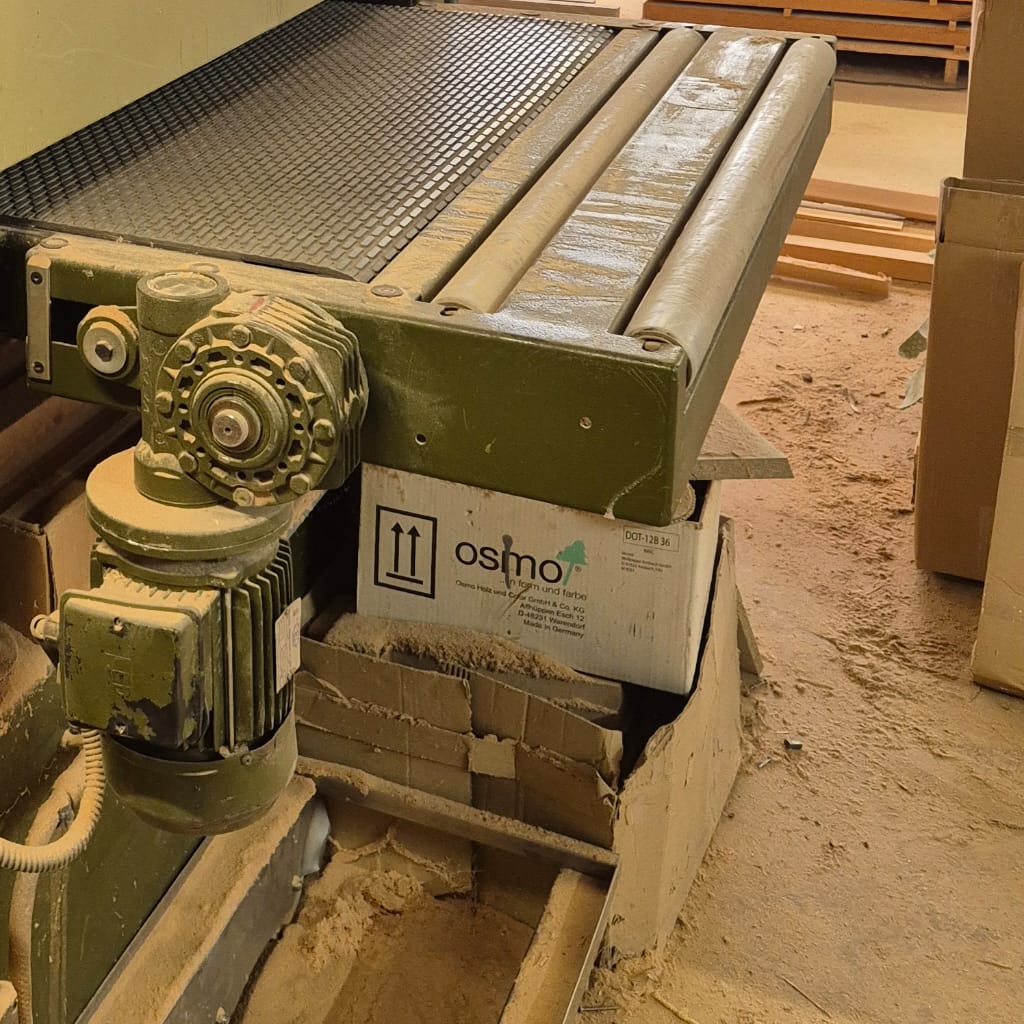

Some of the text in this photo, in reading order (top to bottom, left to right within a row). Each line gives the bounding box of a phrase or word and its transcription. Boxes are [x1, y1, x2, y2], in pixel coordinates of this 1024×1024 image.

[625, 530, 671, 547] DOT-12B 36
[455, 541, 563, 584] osmo
[541, 586, 561, 596] und
[562, 588, 587, 601] farbe
[573, 606, 585, 614] KG
[523, 619, 543, 629] Made
[552, 625, 585, 639] Germany
